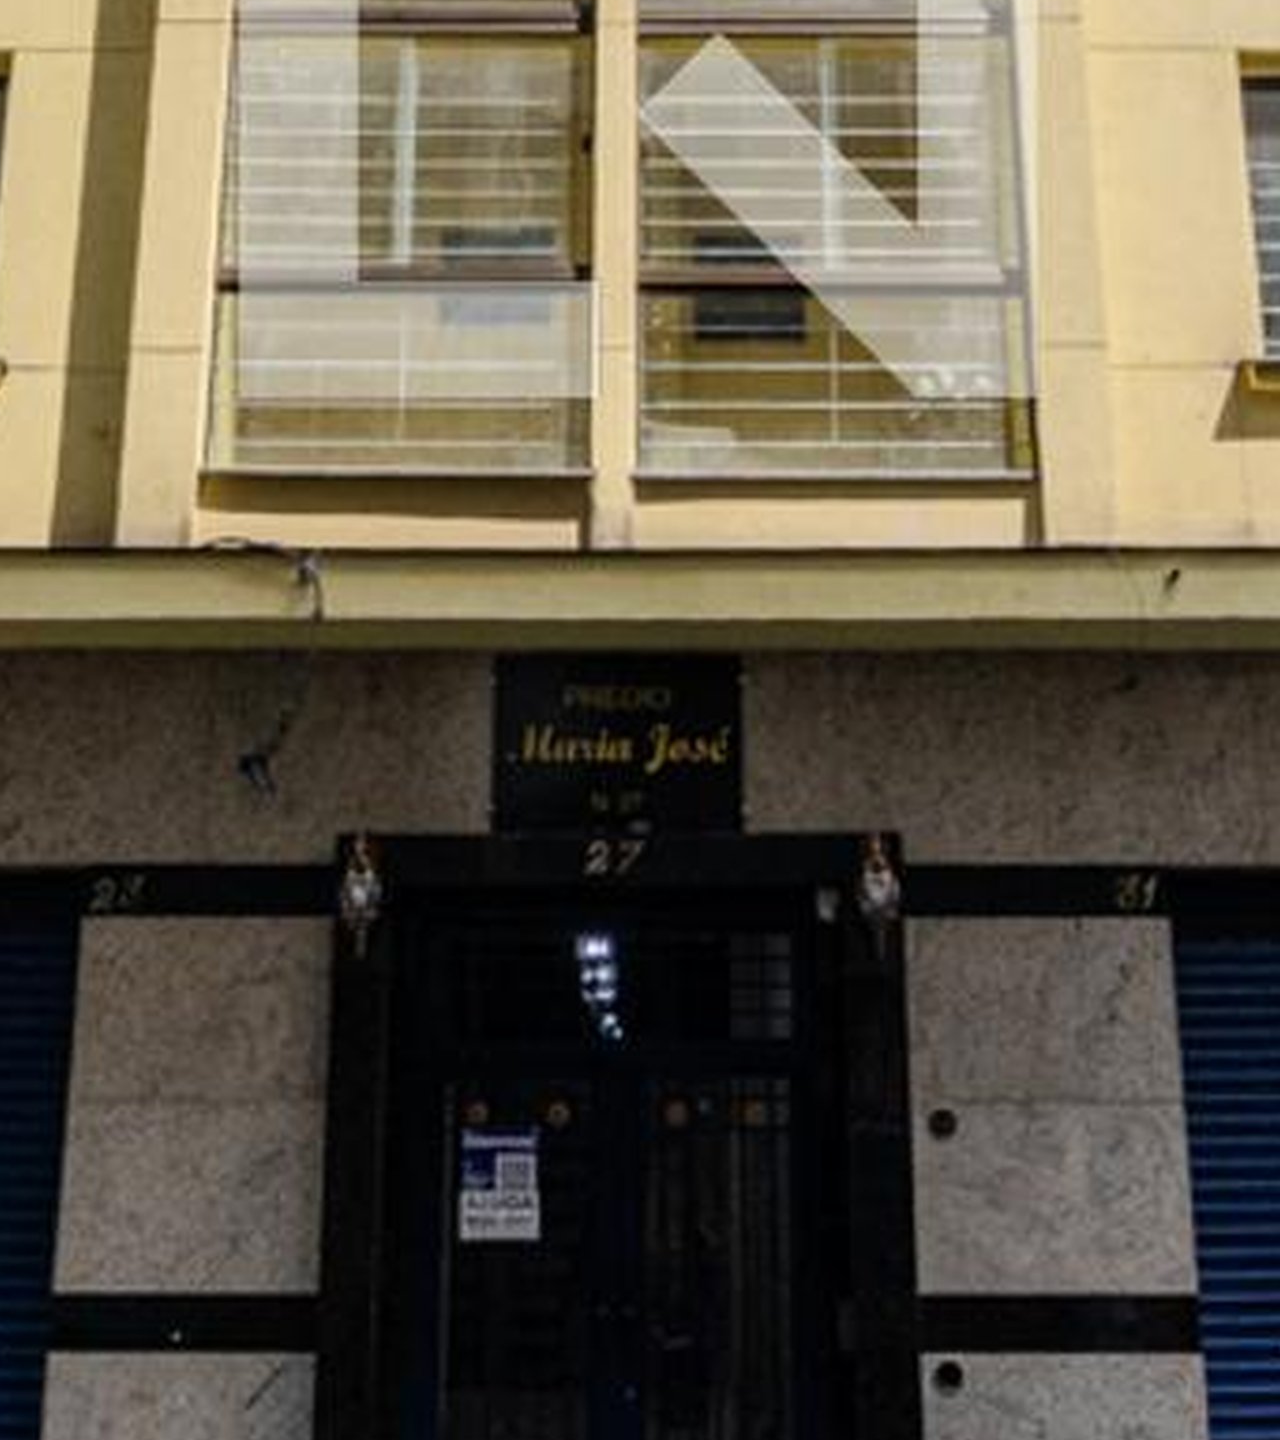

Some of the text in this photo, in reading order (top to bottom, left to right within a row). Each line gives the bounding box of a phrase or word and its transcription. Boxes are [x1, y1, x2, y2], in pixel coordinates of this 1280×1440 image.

[523, 722, 731, 775] Maria José
[583, 839, 647, 875] 27
